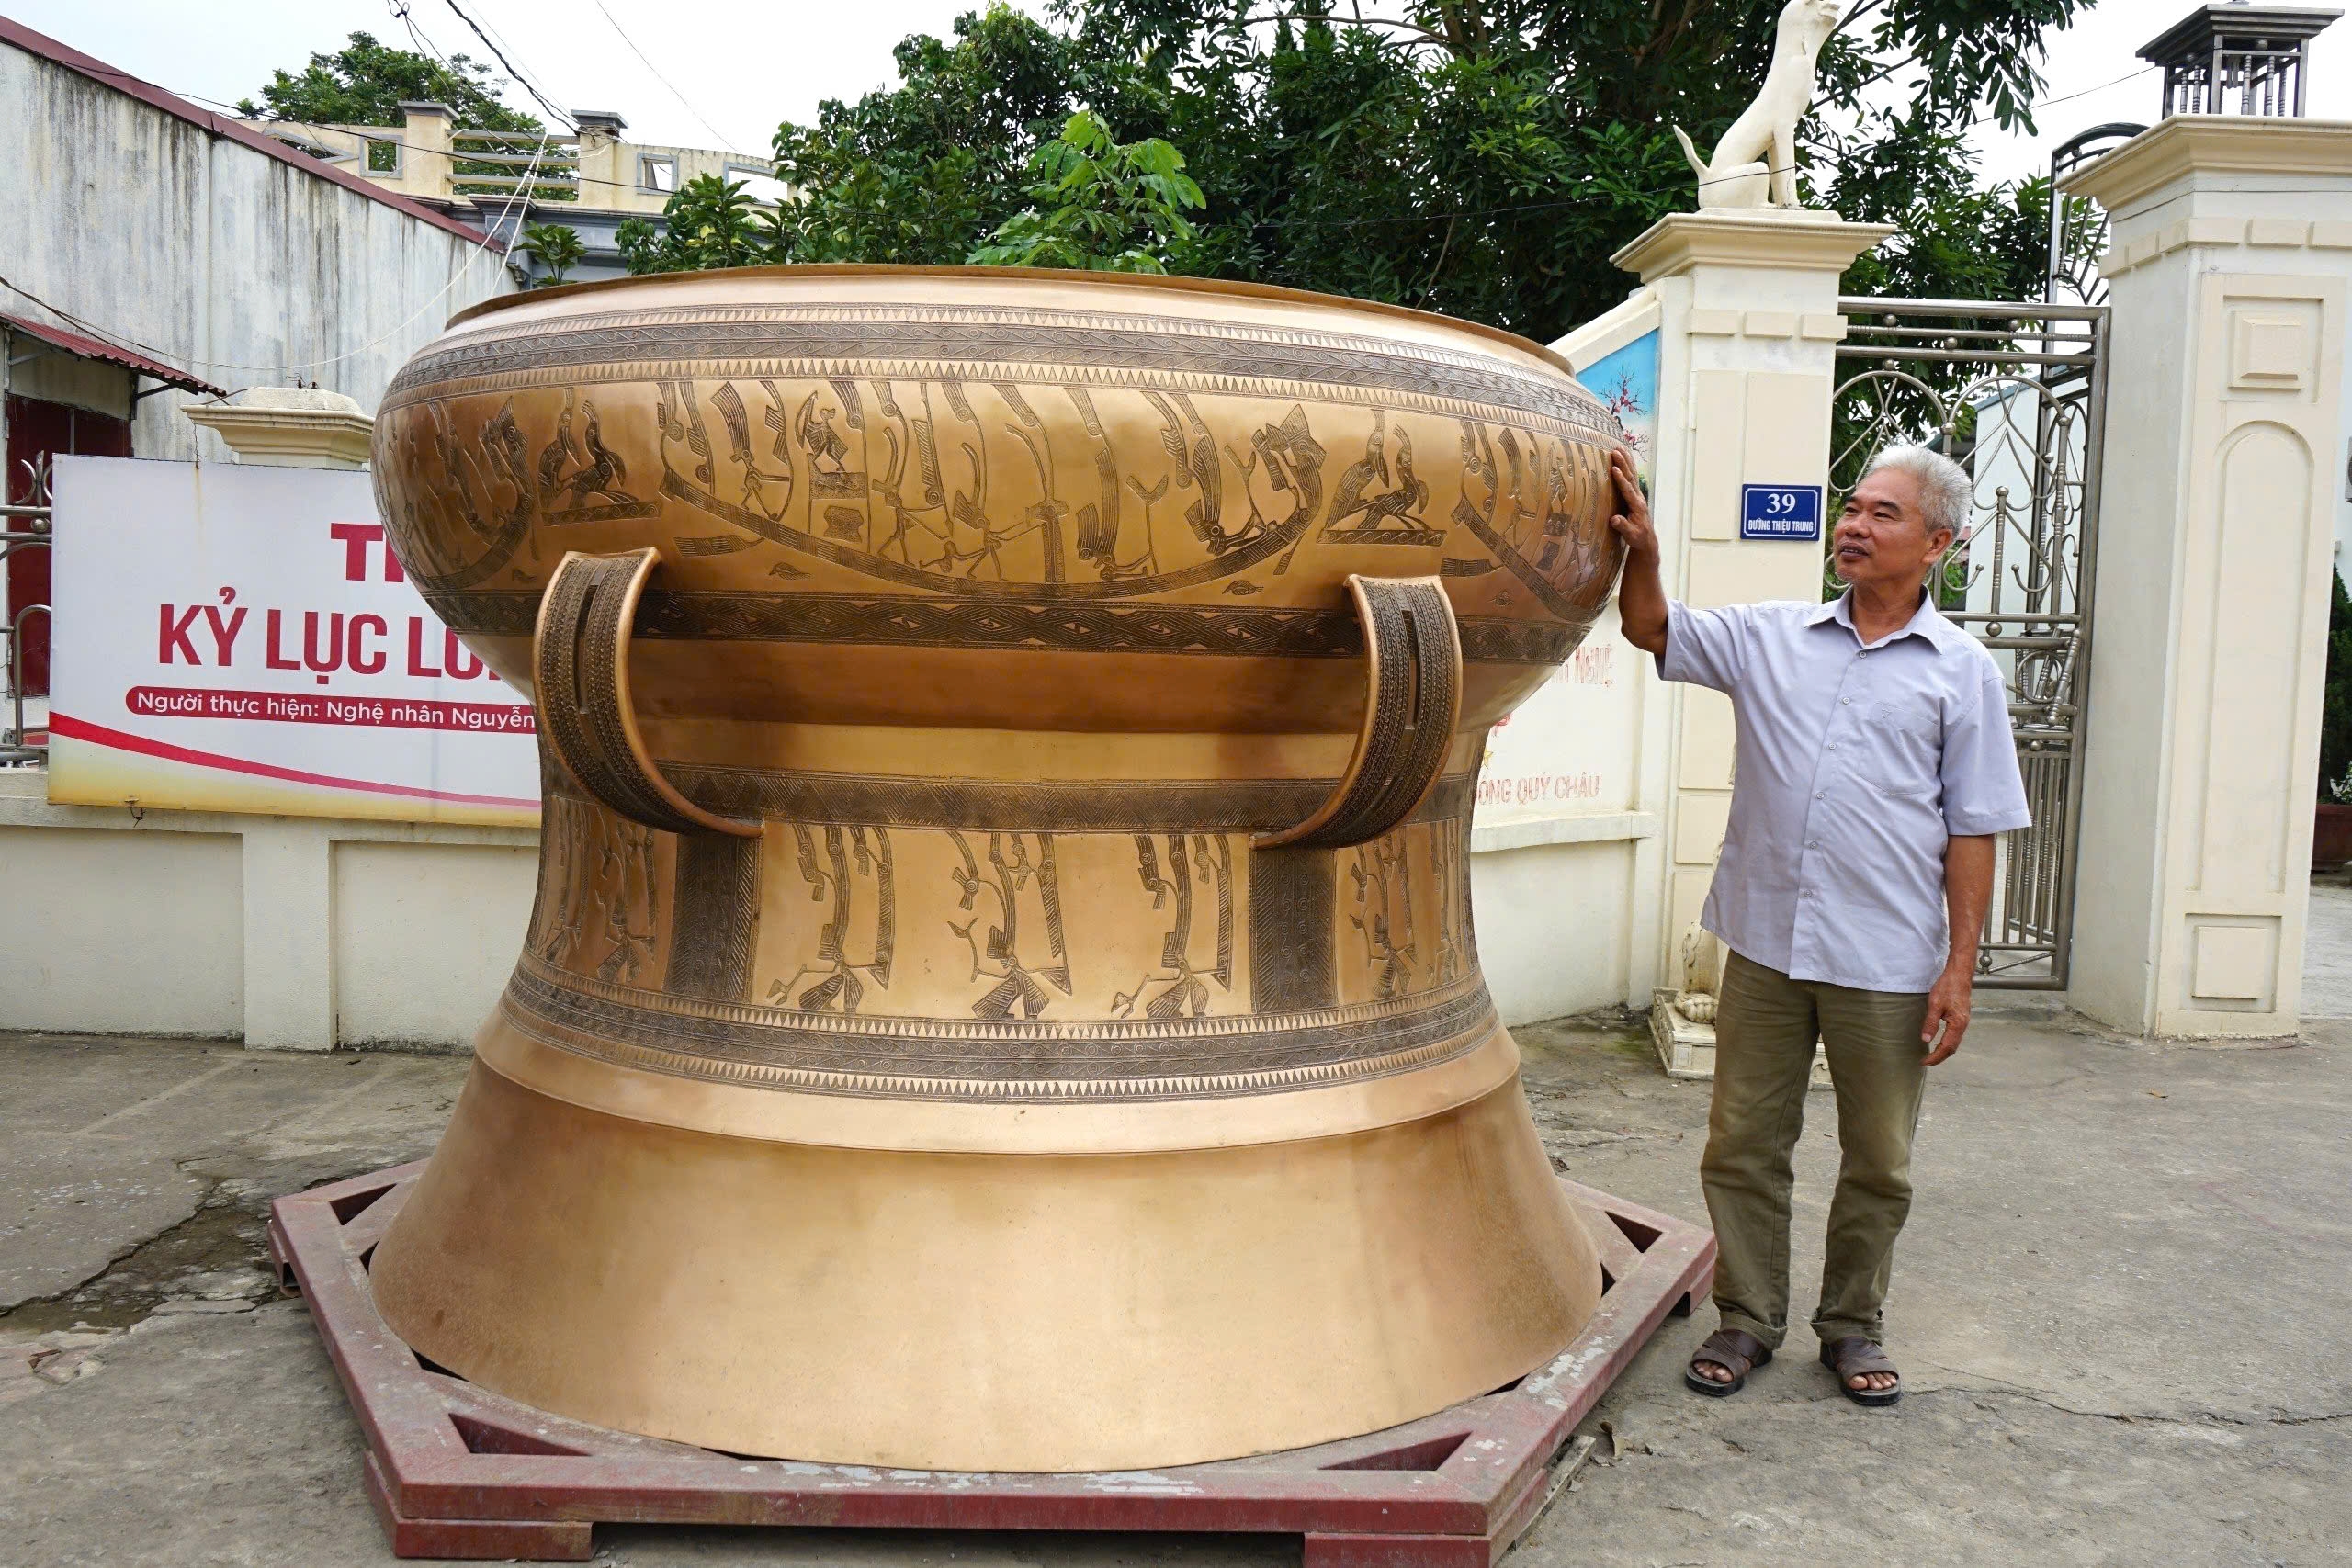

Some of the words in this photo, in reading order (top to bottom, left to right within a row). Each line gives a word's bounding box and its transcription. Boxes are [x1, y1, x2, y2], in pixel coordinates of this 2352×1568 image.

[1766, 493, 1796, 513] 39
[1747, 518, 1770, 531] ĐƯỜNG
[1772, 519, 1791, 534] THIỆU
[1792, 521, 1814, 532] TRUNG
[159, 586, 249, 666] KỶ
[266, 609, 388, 685] LỤC
[137, 692, 202, 715] Người
[210, 695, 260, 717] thực
[267, 698, 319, 719] hiện:
[327, 701, 384, 724] Nghệ
[391, 705, 444, 724] nhân
[452, 705, 535, 729] Nguyễn
